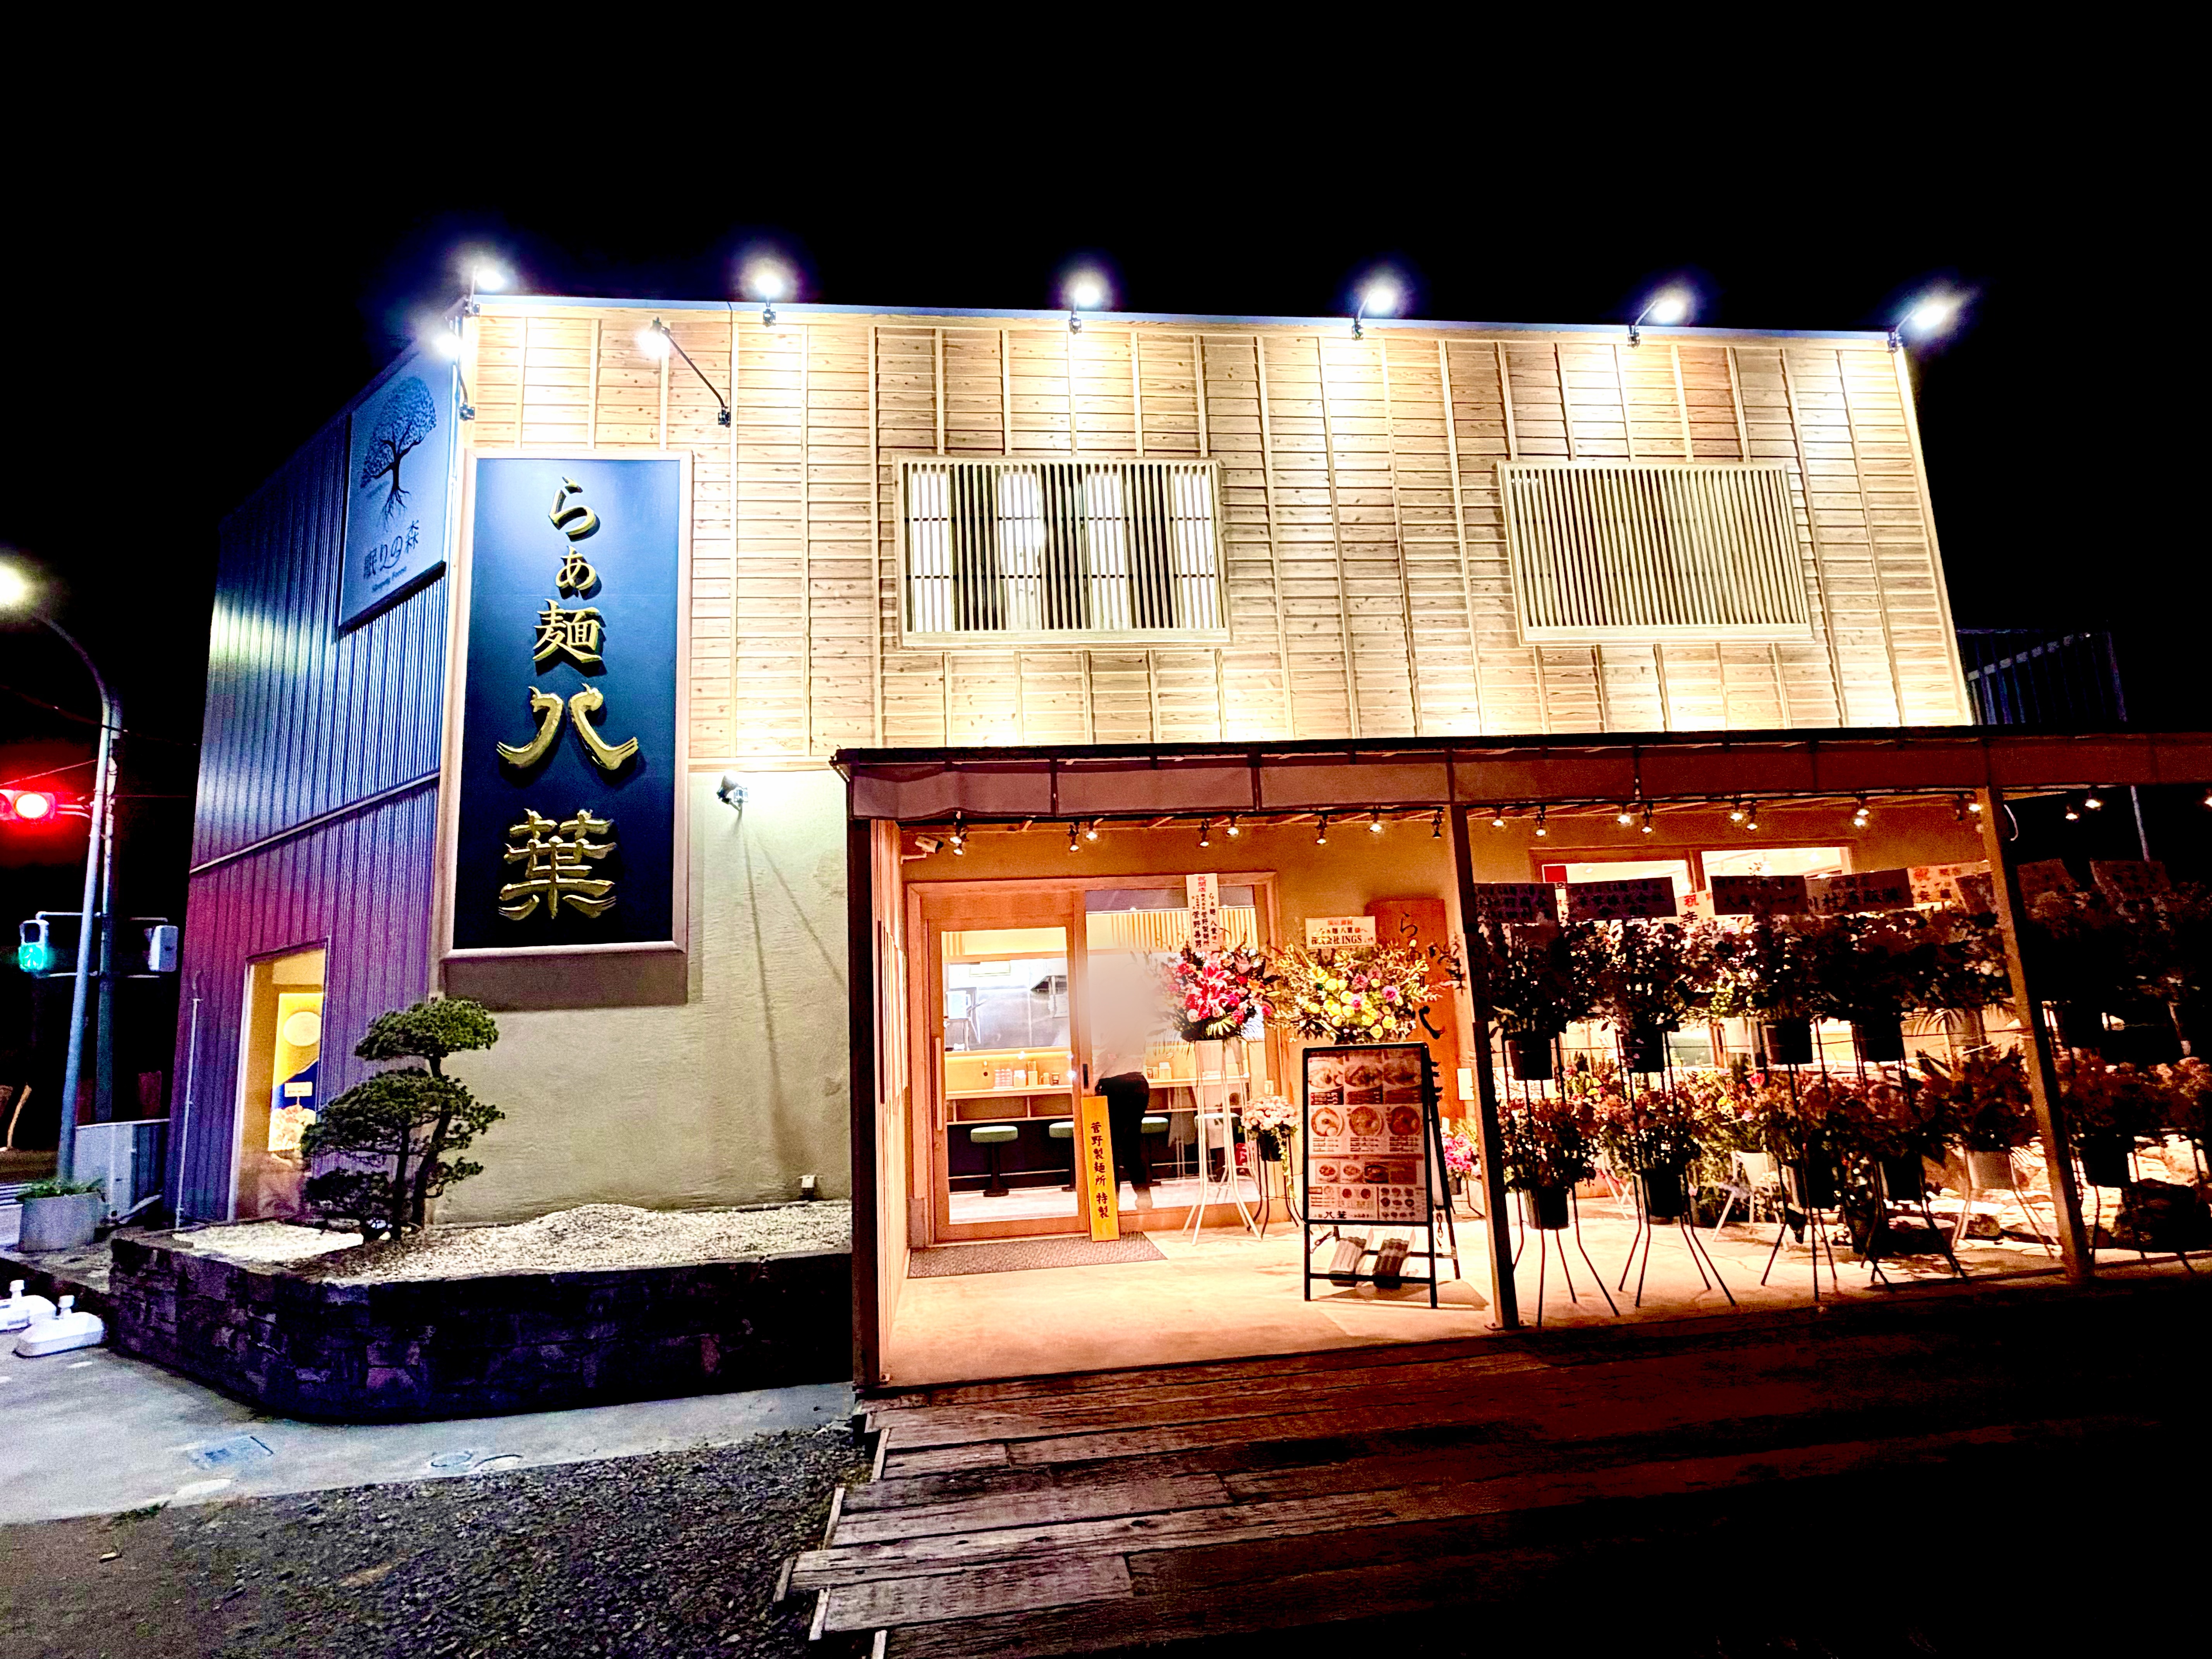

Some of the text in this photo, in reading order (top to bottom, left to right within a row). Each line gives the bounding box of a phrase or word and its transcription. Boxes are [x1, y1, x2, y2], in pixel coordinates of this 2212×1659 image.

[1341, 935, 1362, 944] INGS
[1091, 1121, 1109, 1218] 菅野製麺所 特製
